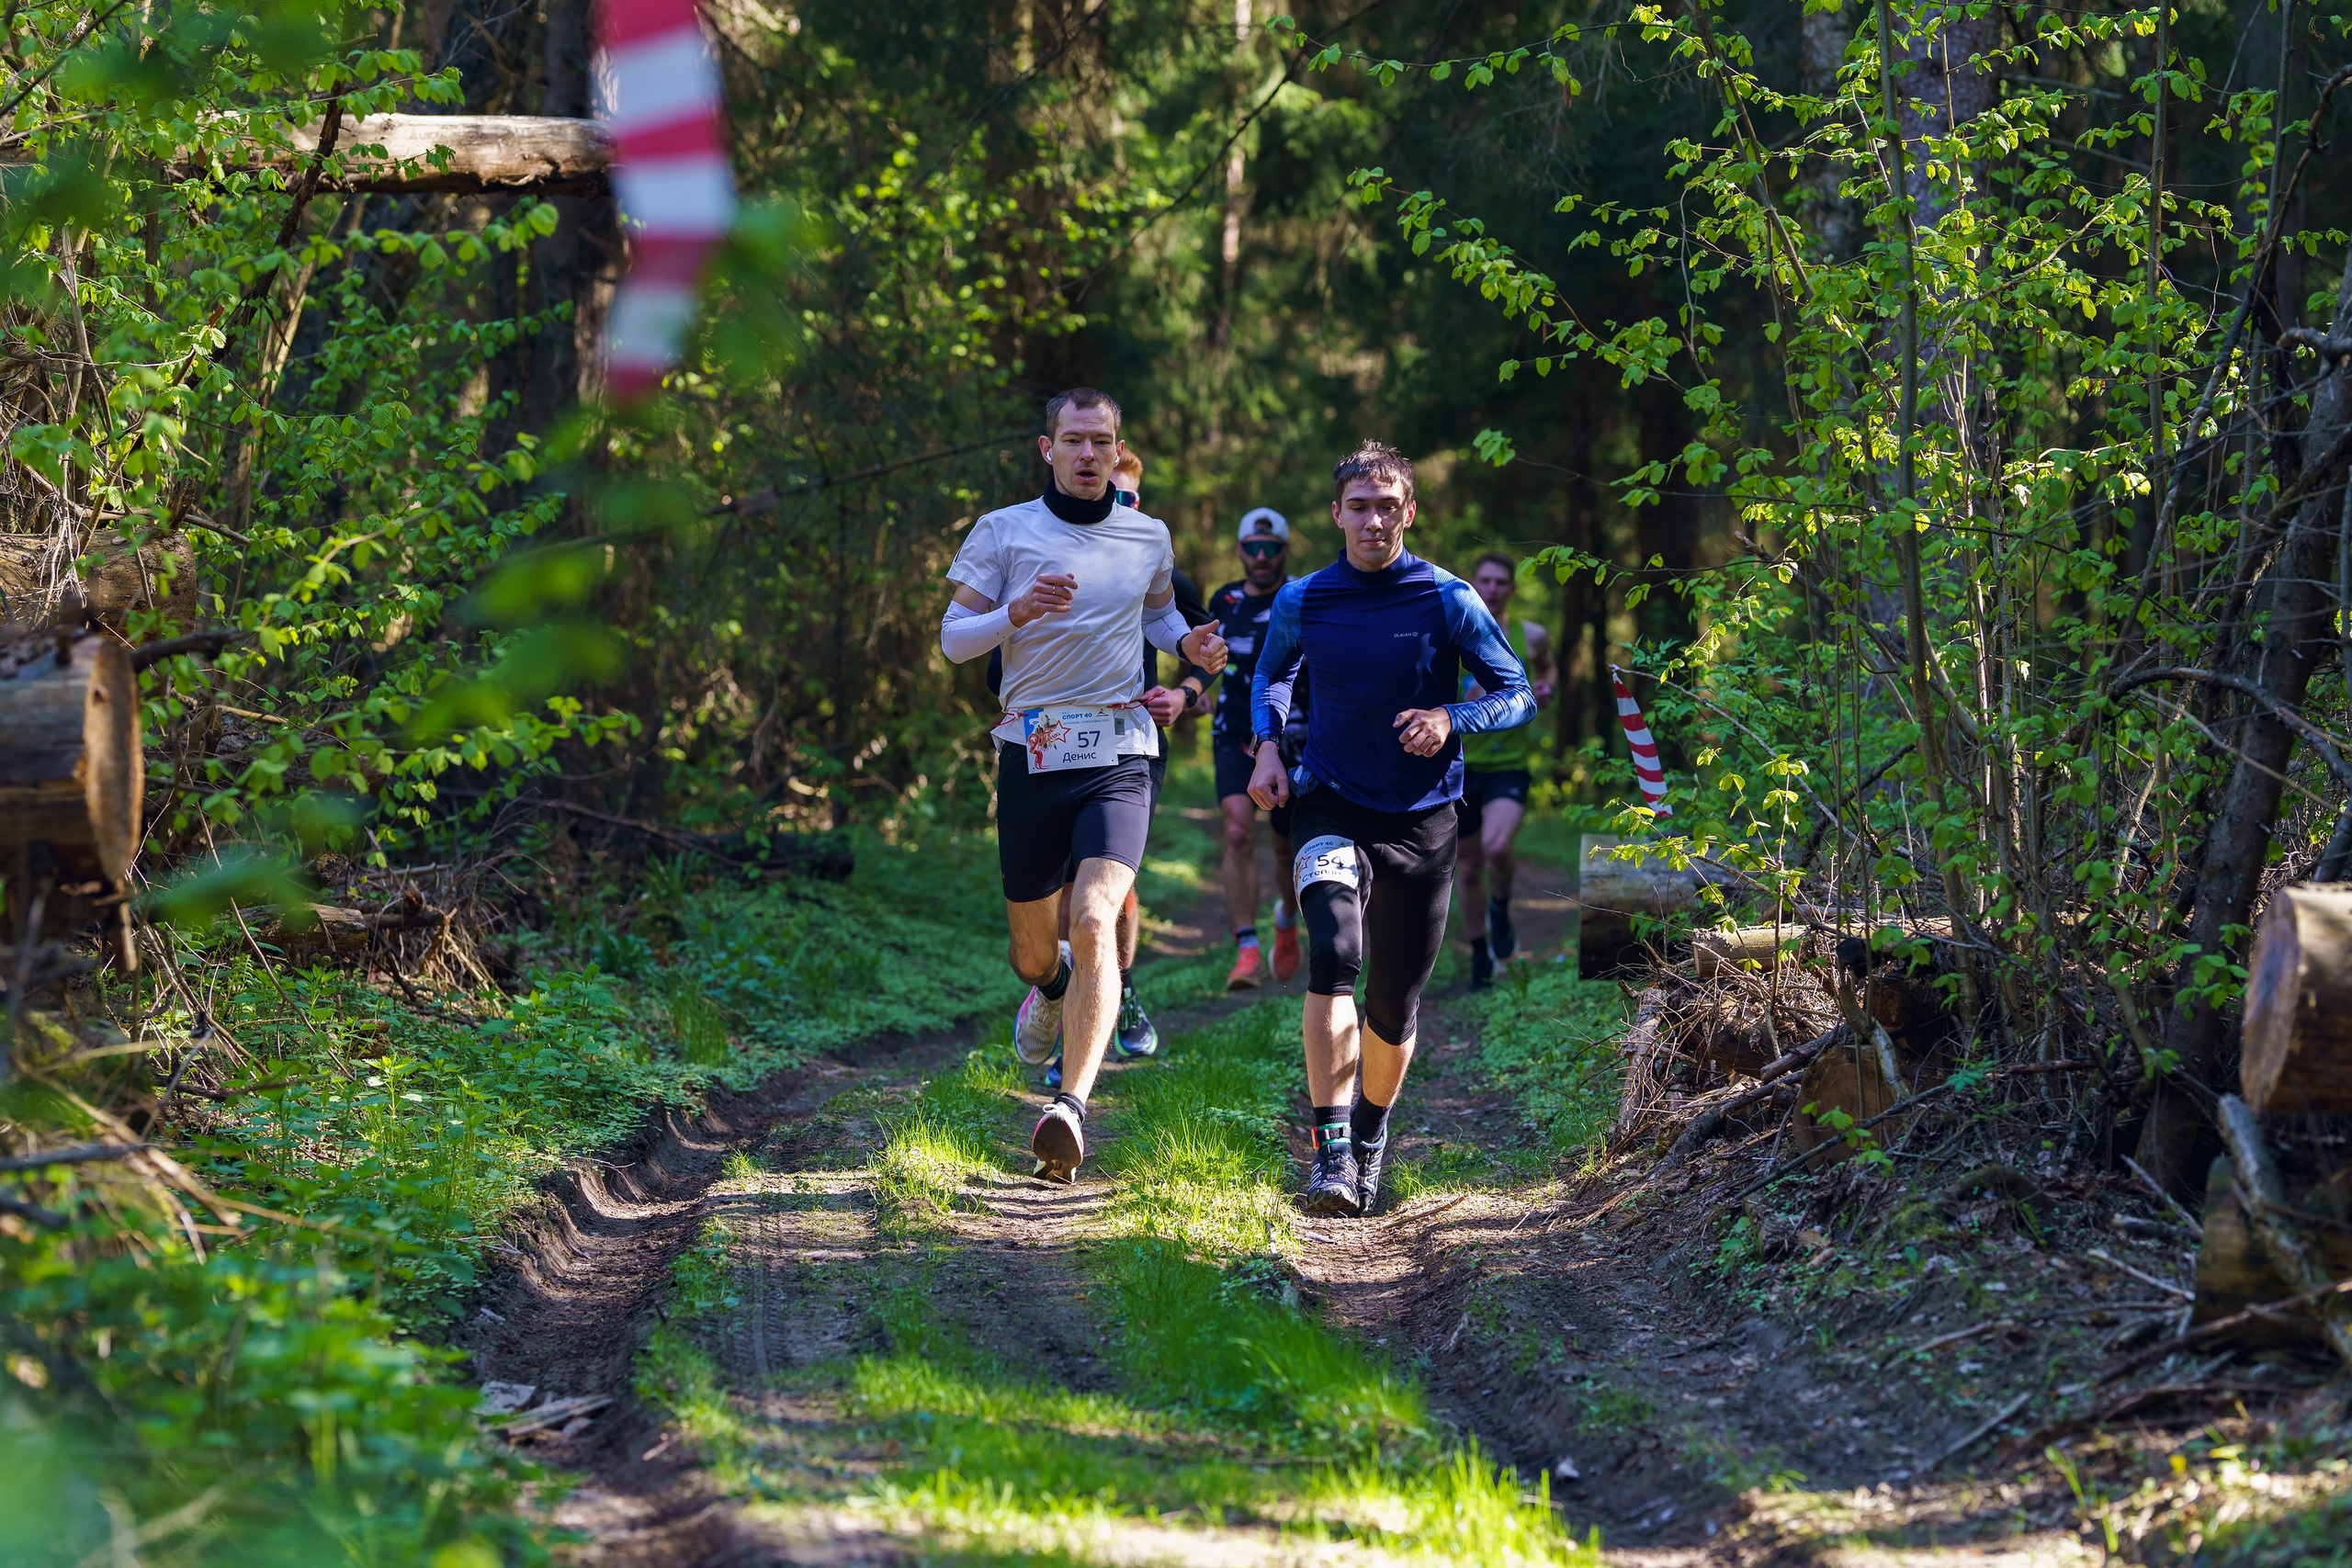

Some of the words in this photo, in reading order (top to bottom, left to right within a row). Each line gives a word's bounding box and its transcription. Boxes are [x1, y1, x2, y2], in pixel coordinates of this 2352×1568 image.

[1078, 730, 1101, 748] 57
[1063, 751, 1097, 763] Денис
[1317, 854, 1344, 867] 54
